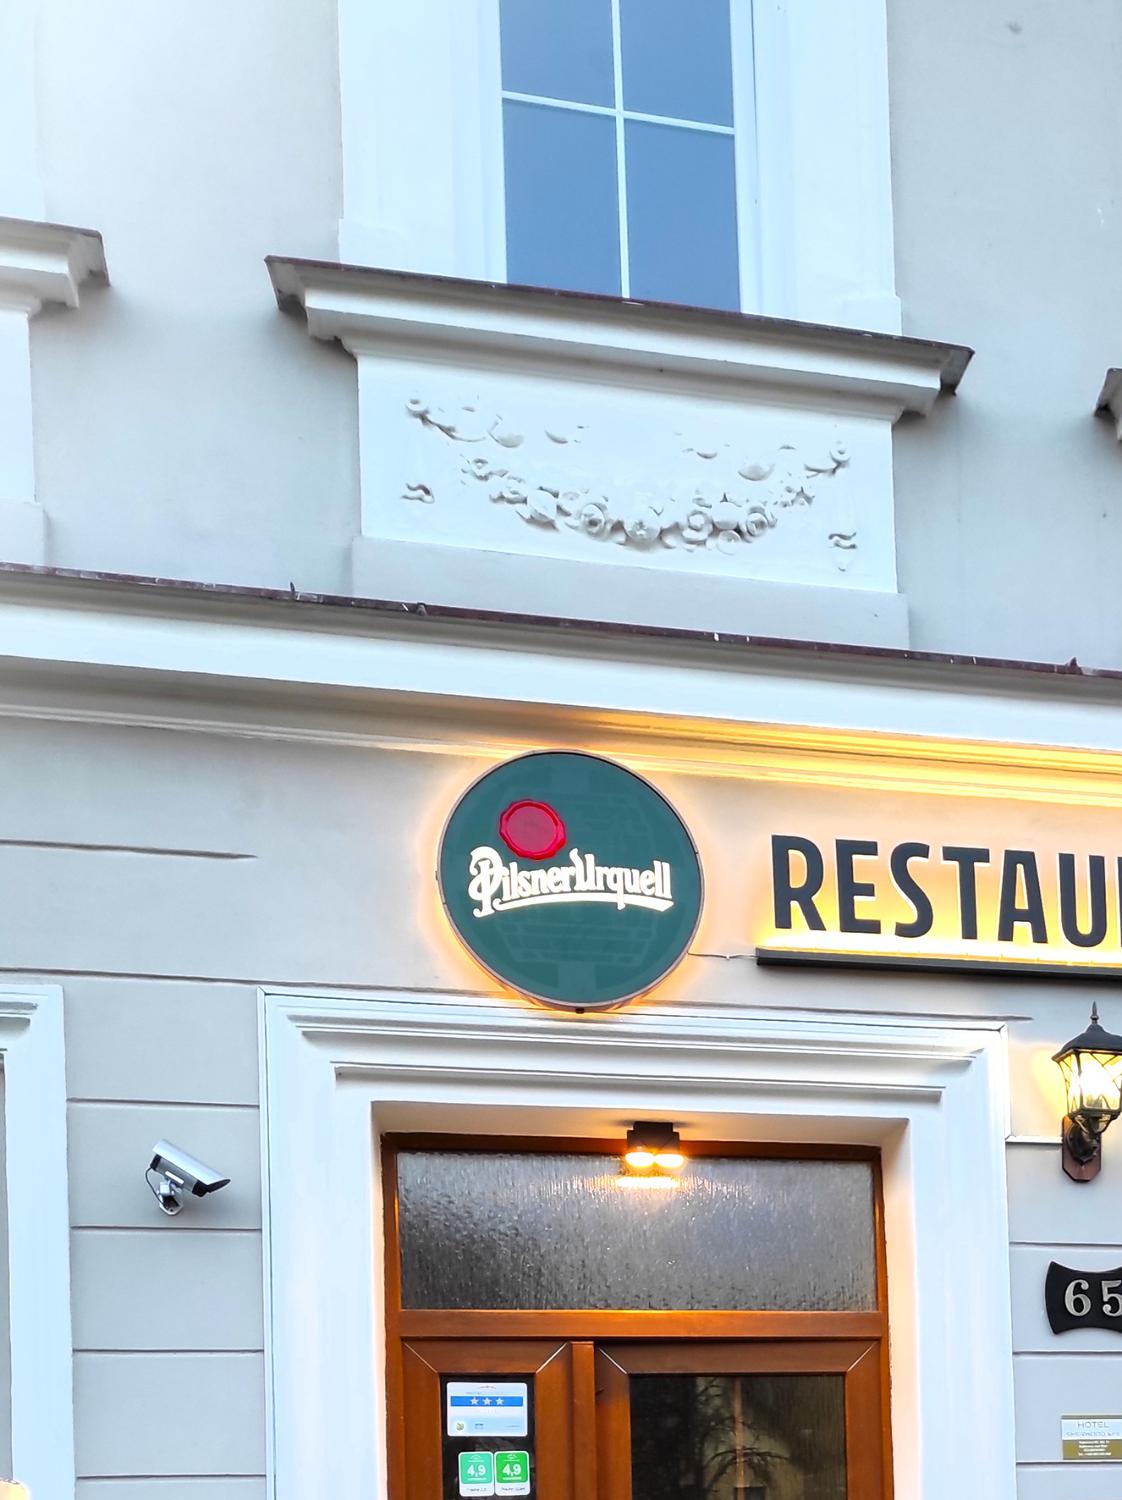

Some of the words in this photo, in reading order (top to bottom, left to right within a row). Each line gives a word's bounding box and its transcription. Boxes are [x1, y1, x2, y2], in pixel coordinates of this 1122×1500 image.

[468, 846, 576, 918] Pilsner
[569, 848, 673, 910] Urquell
[502, 1463, 522, 1477] 4,9
